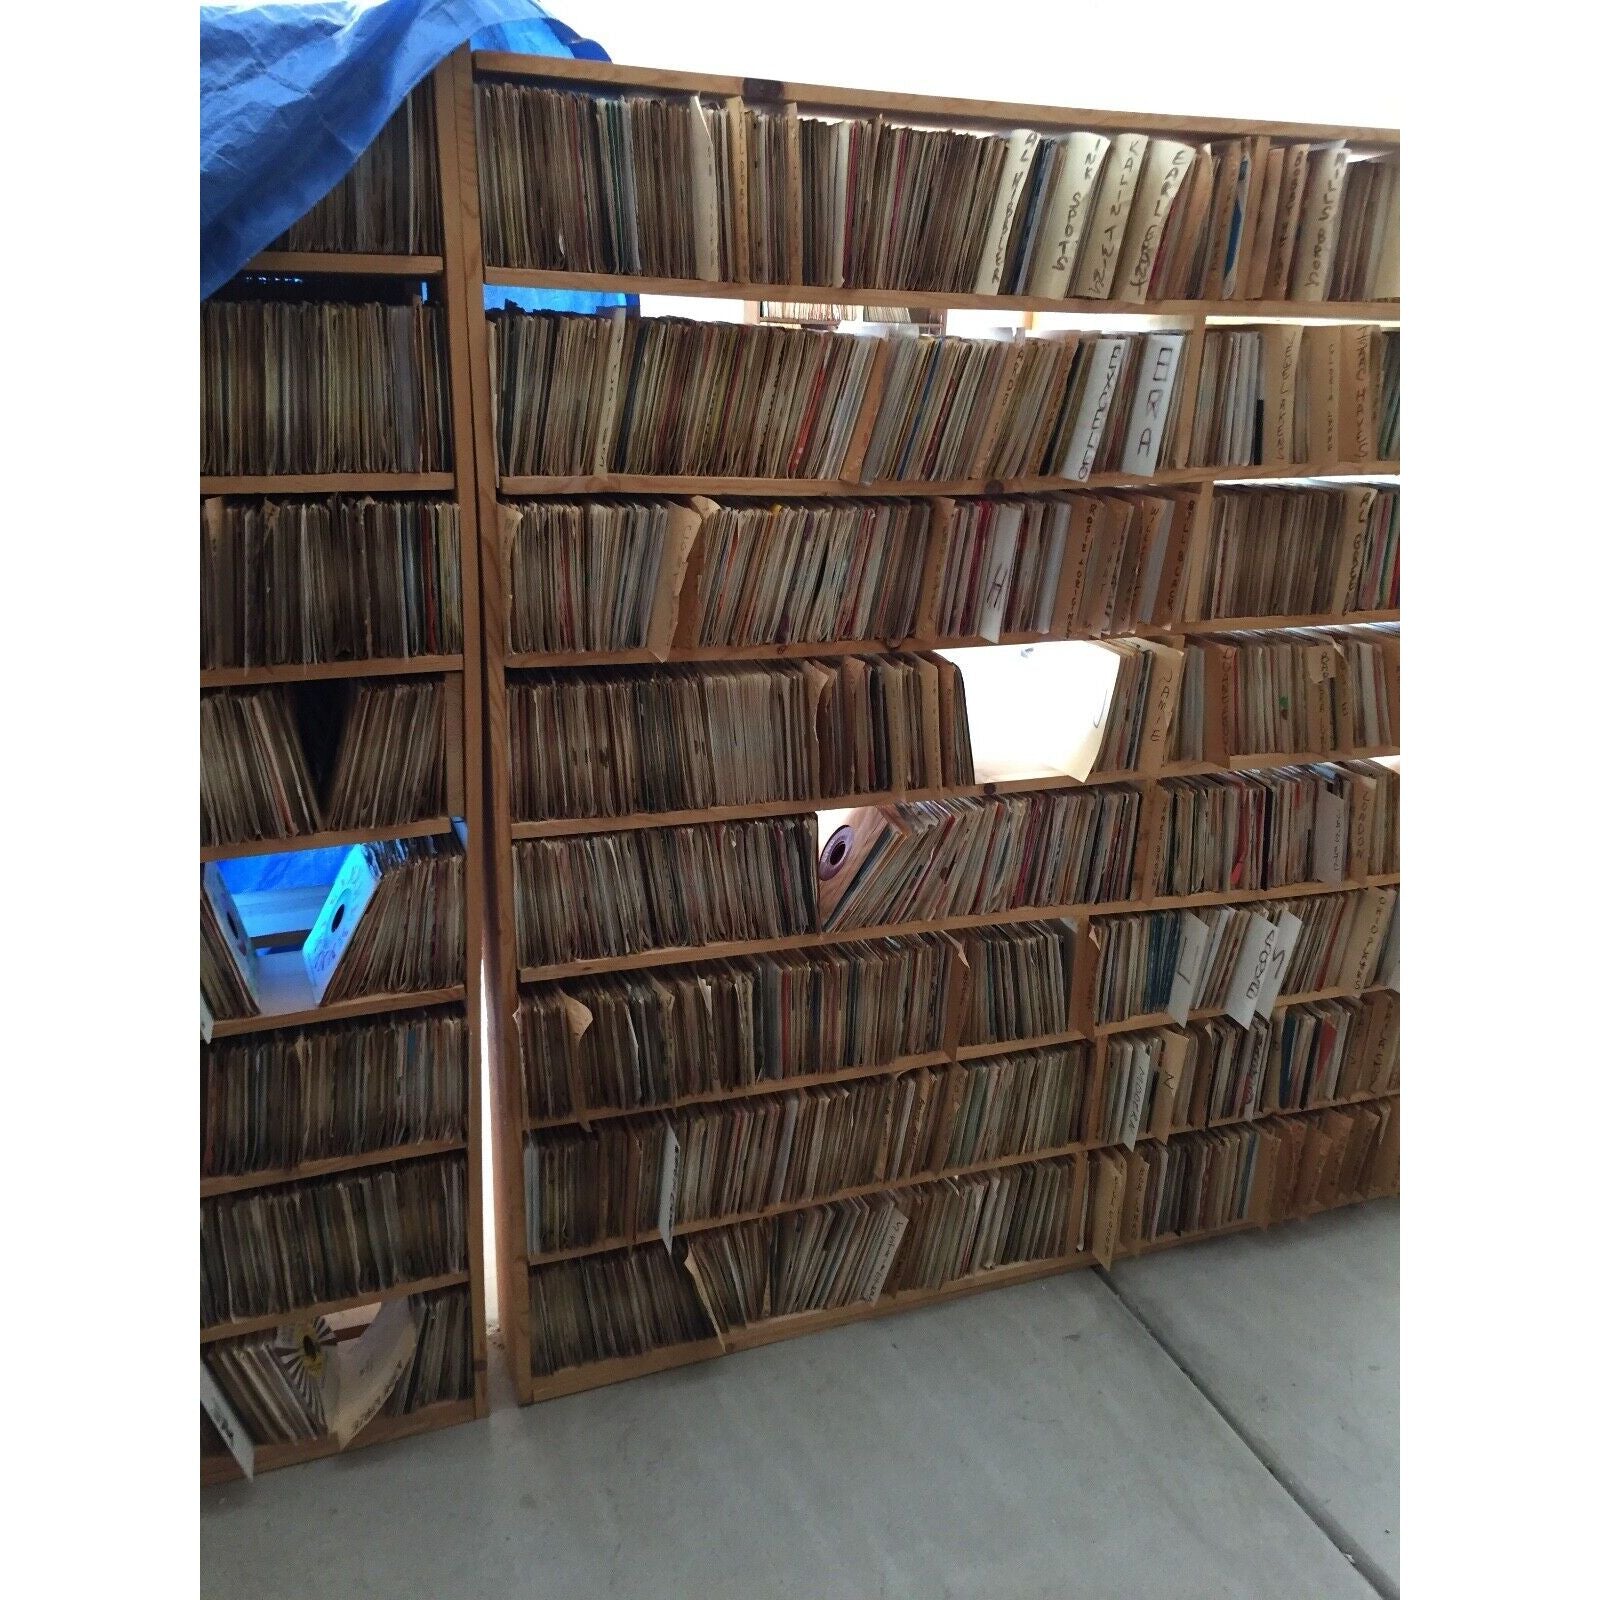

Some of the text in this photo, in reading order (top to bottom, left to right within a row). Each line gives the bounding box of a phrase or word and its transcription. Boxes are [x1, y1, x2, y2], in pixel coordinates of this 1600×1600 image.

[1020, 133, 1038, 162] AL
[1110, 140, 1139, 216] KALIN
[1153, 150, 1185, 217] EARL
[1051, 138, 1102, 271] INK SPOTS
[1318, 152, 1347, 221] MILLS
[1078, 345, 1122, 479] EXCELLO
[1137, 347, 1173, 457] ERA
[986, 564, 1008, 608] H
[1150, 669, 1173, 741] JAMIE
